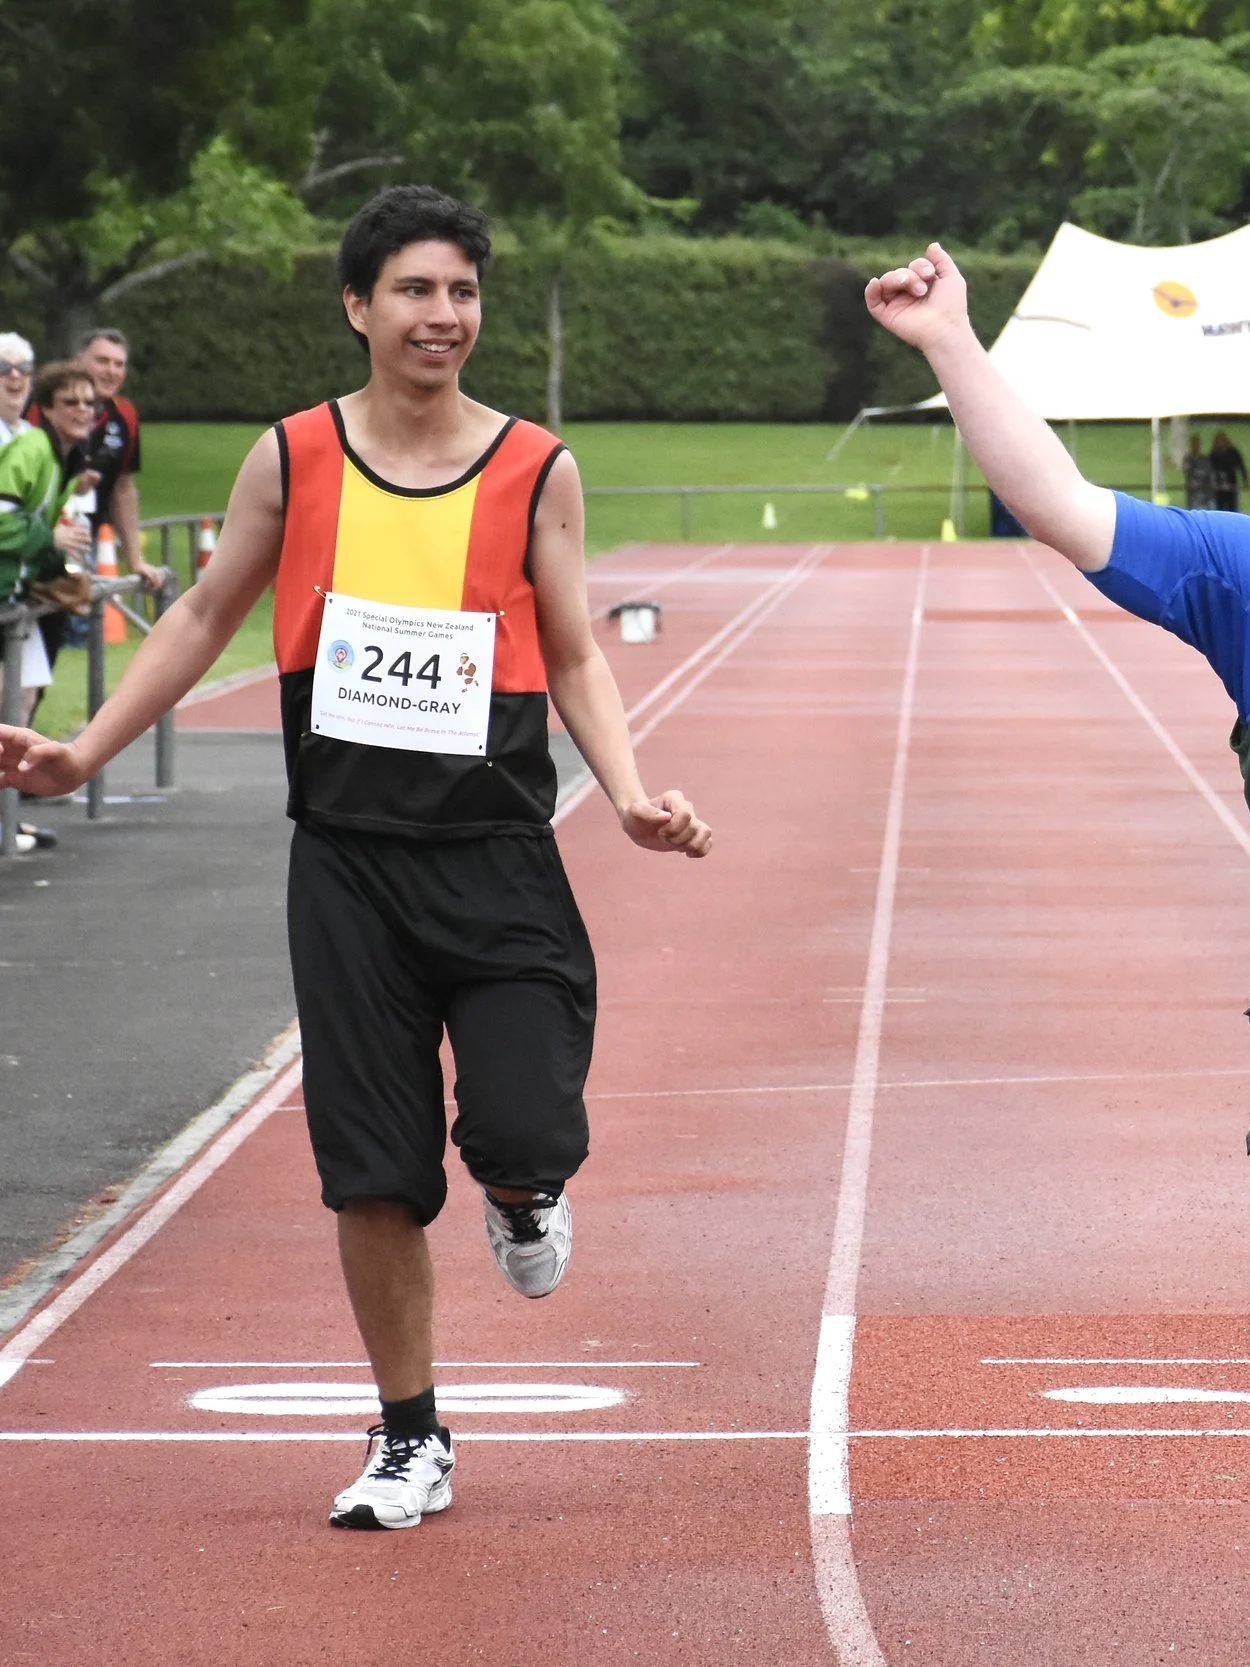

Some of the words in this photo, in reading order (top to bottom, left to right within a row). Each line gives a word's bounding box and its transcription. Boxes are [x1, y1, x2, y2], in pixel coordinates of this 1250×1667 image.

[346, 608, 361, 618] 2021
[362, 611, 388, 623] Special
[389, 616, 425, 628] Olympics
[426, 621, 443, 630] New
[445, 622, 474, 632] Zealand
[362, 621, 393, 634] National
[394, 627, 426, 638] Summer
[428, 631, 454, 640] Games
[360, 645, 442, 690] 244
[338, 687, 461, 715] DIAMOND-GRAY
